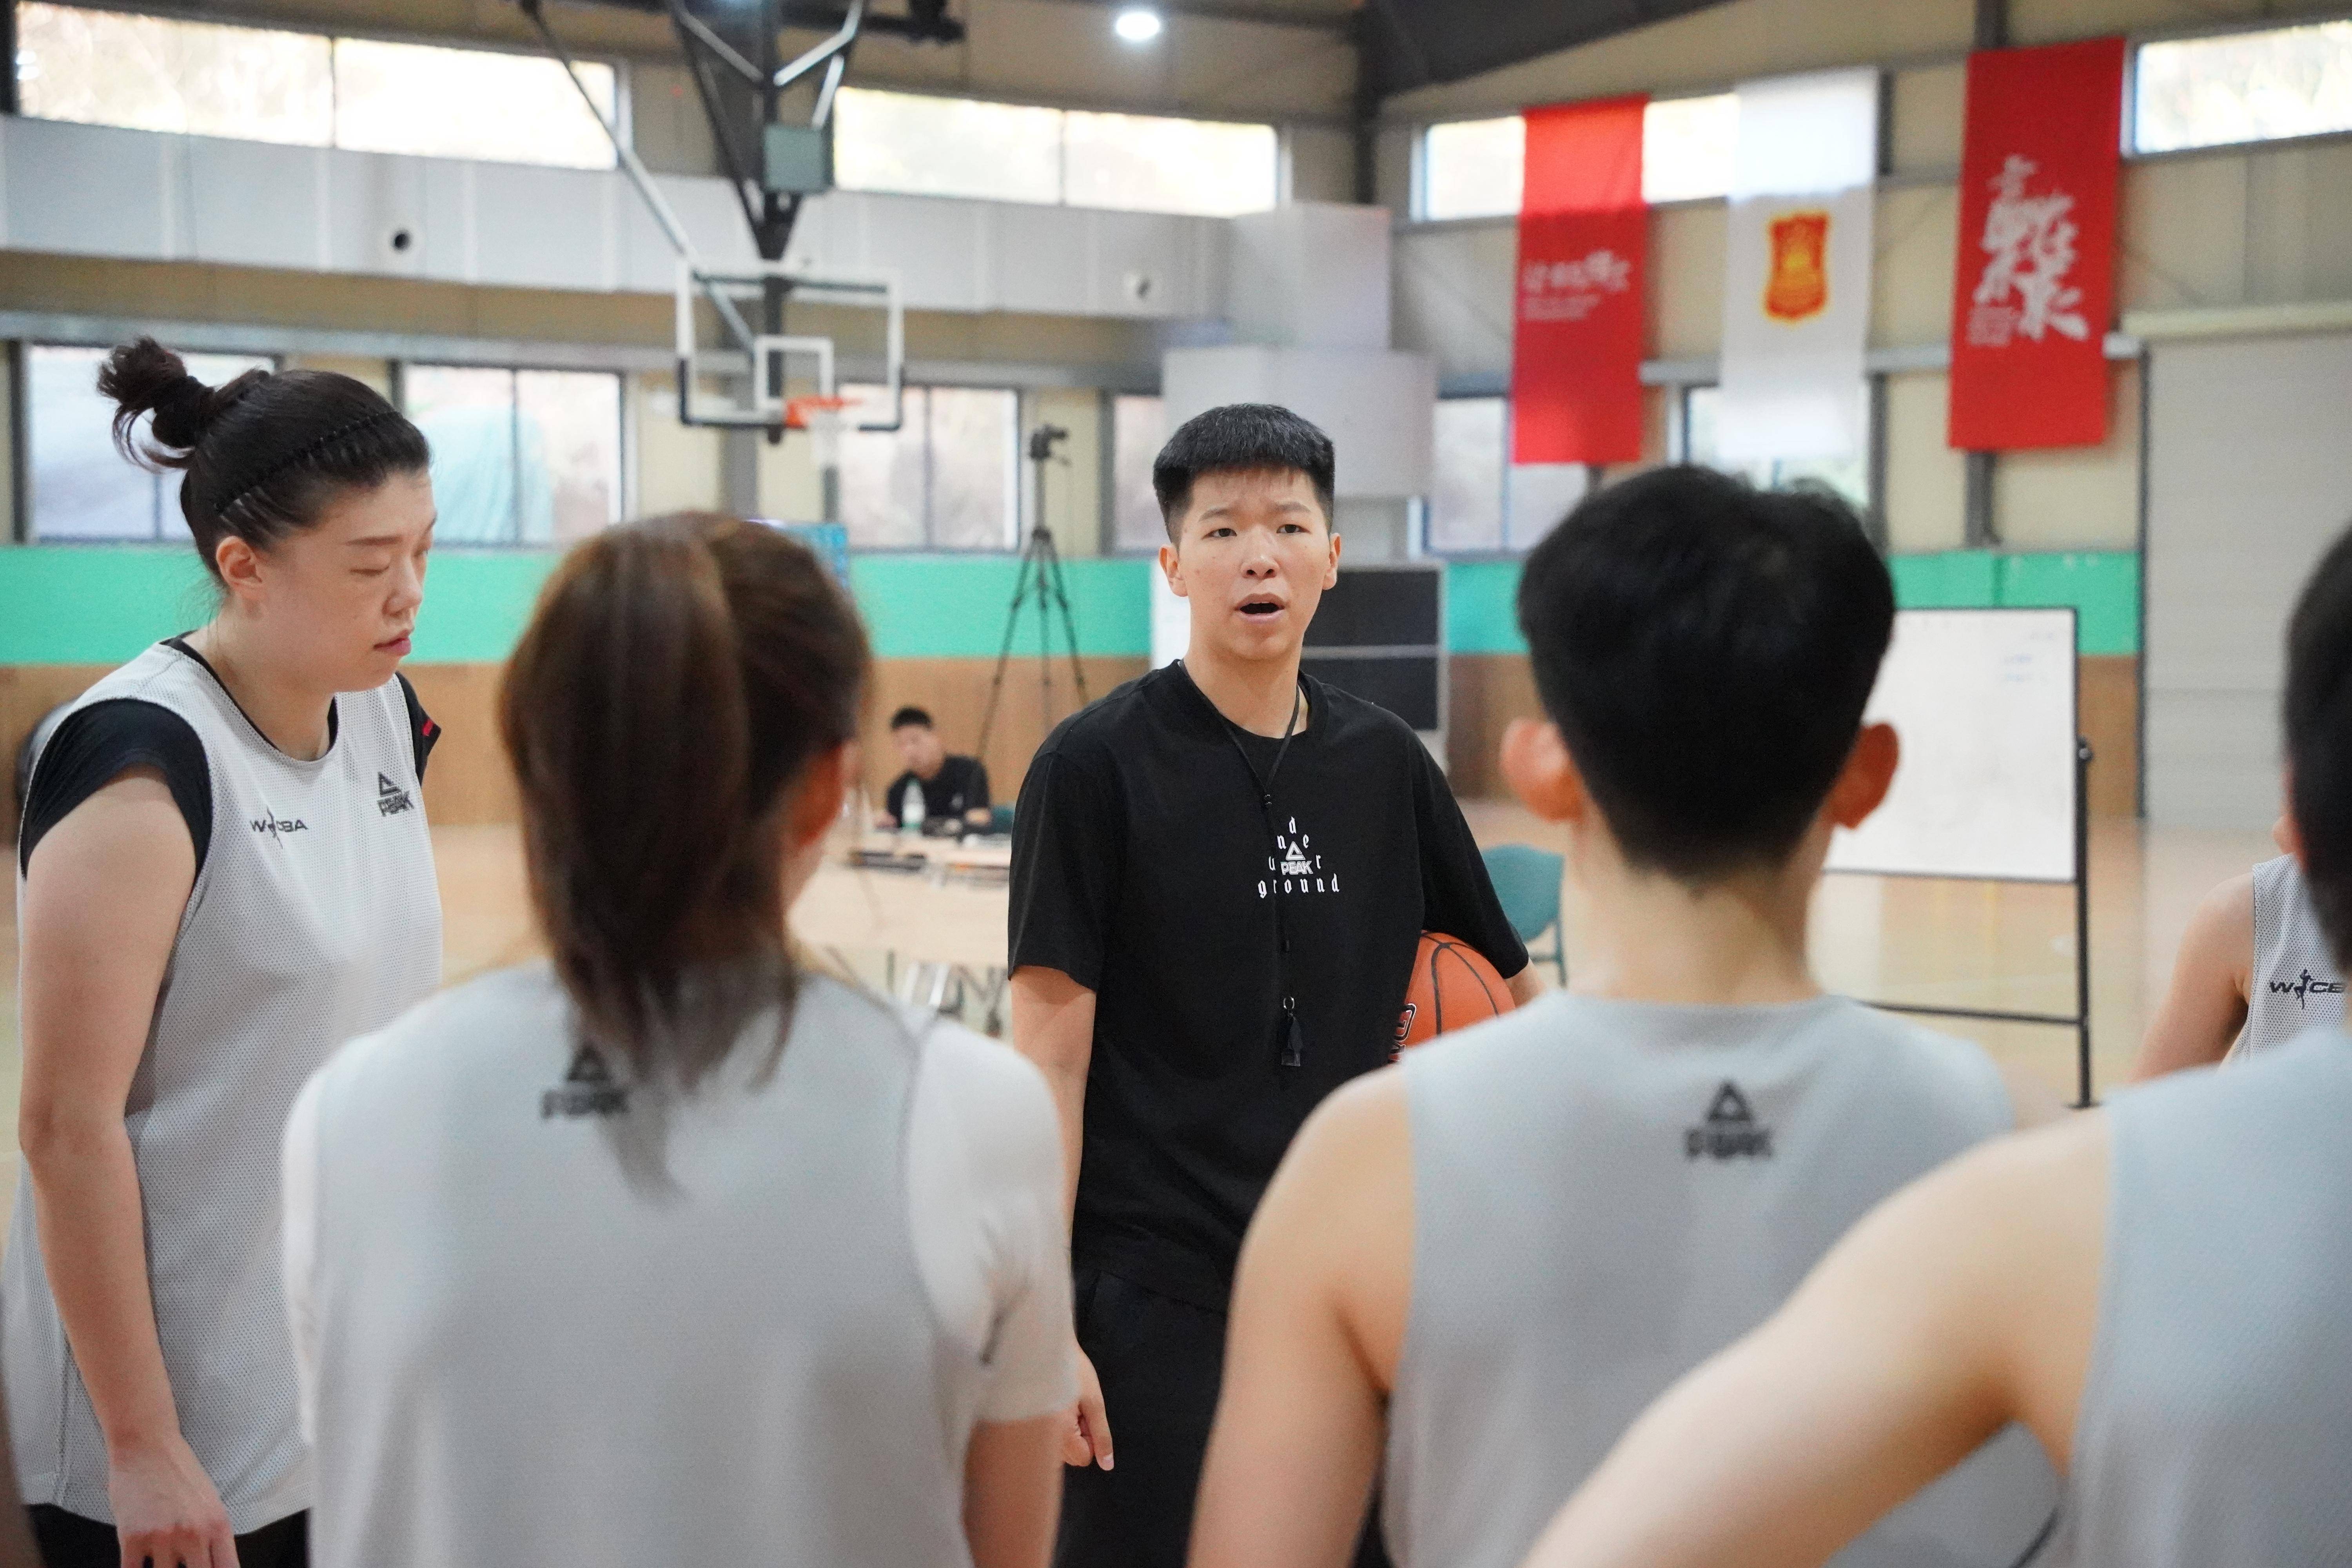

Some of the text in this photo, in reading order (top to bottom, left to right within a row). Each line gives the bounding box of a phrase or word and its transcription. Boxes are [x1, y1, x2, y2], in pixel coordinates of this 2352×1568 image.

[376, 790, 414, 816] PEAK
[1280, 860, 1313, 875] PEAK
[1258, 873, 1339, 898] ground
